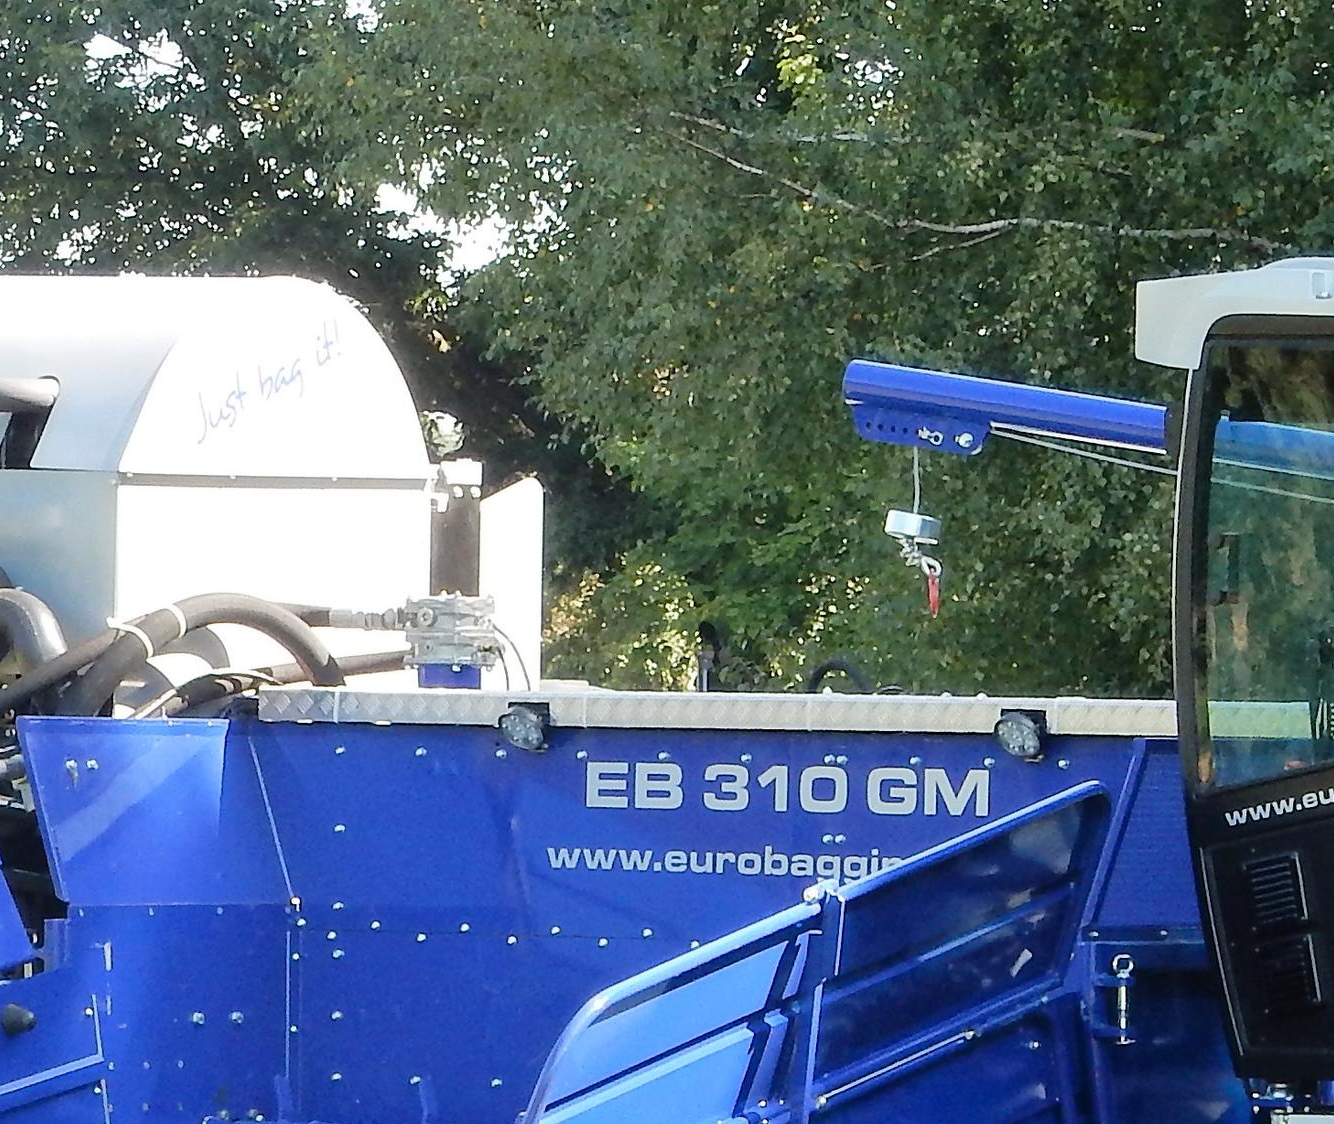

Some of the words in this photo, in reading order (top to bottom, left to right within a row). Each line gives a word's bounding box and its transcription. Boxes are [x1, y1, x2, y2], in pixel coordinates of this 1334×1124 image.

[196, 370, 248, 445] Just
[584, 761, 685, 811] EB
[703, 764, 849, 815] 310
[867, 766, 991, 818] GM
